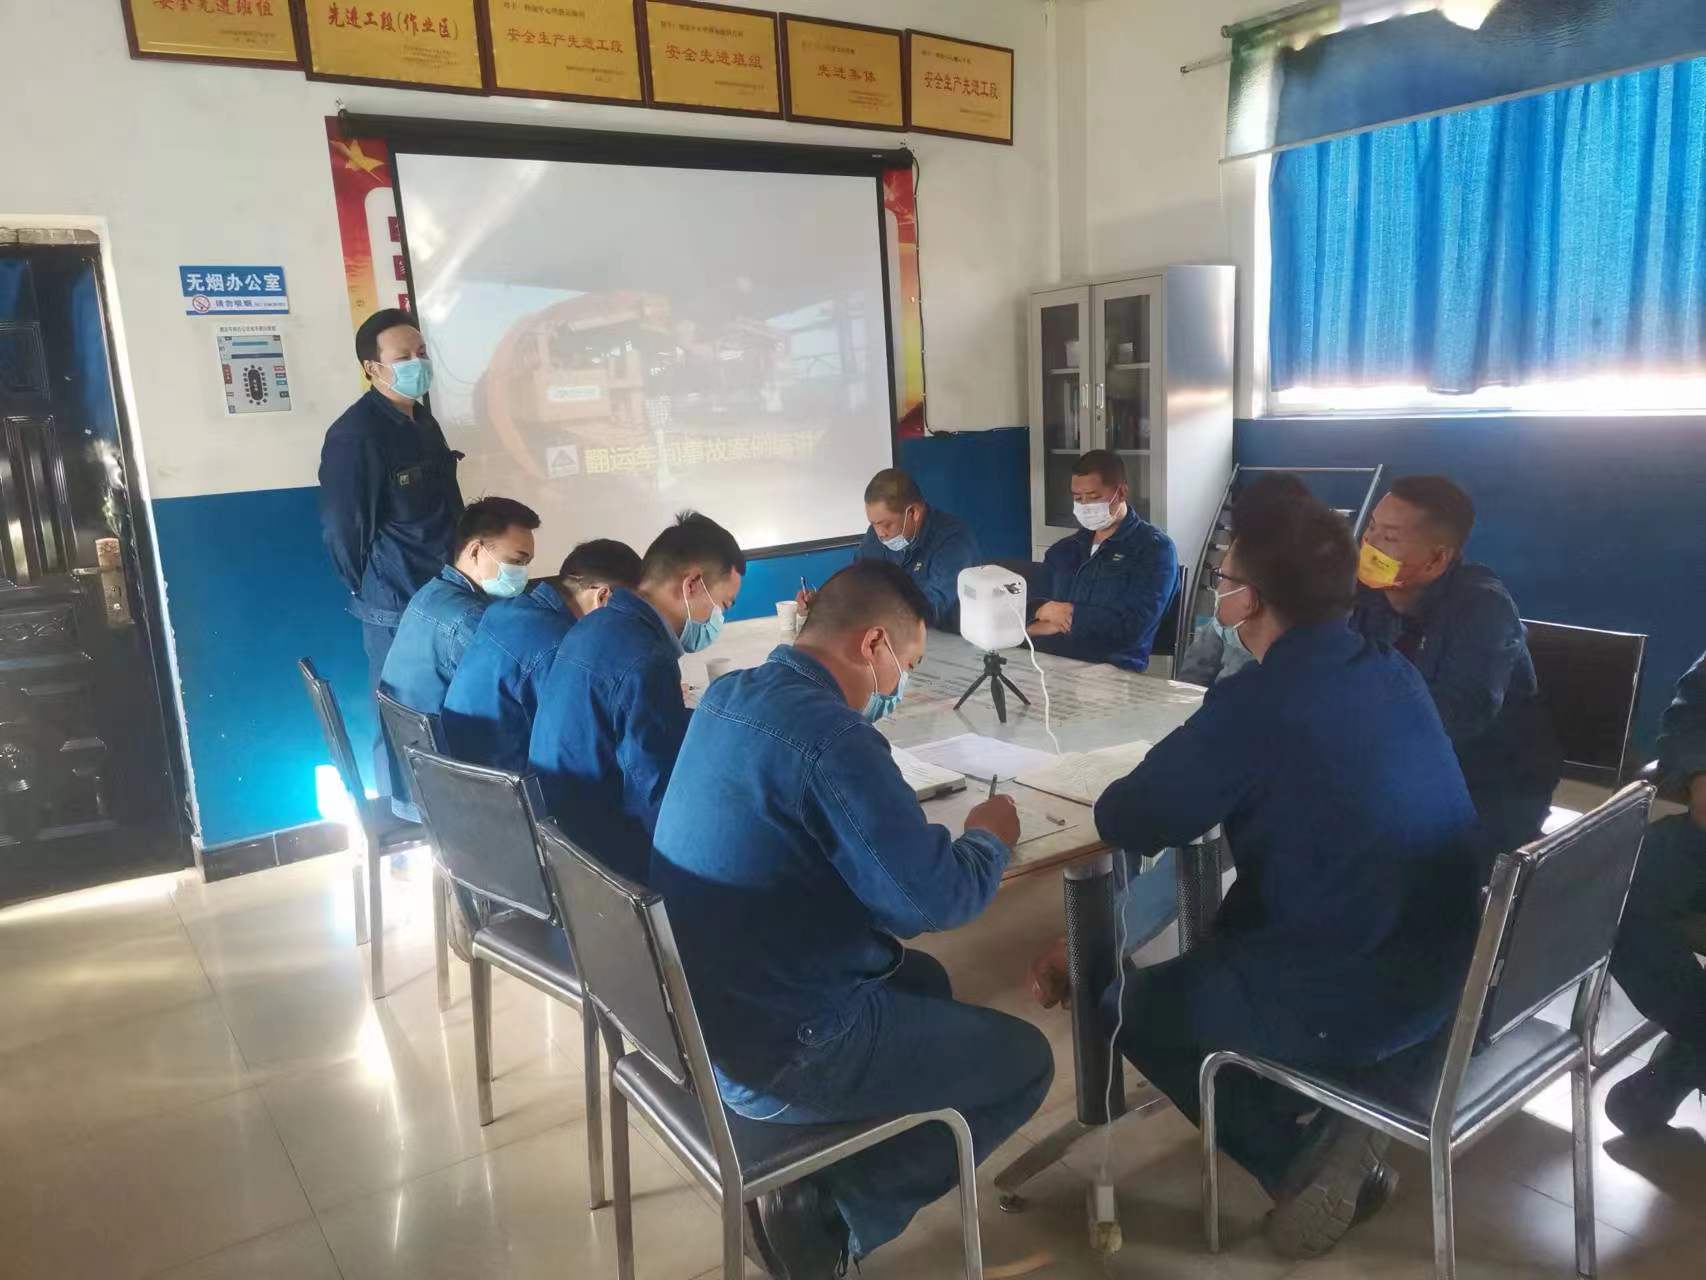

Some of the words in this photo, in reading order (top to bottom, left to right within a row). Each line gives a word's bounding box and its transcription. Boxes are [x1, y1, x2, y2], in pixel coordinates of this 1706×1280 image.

[506, 27, 625, 54] 安全生产先进工段
[665, 43, 764, 70] 安全先进班组
[817, 64, 877, 83] 先进集体
[924, 71, 1000, 100] 安全生产先进工段
[186, 272, 282, 292] 无烟办公室
